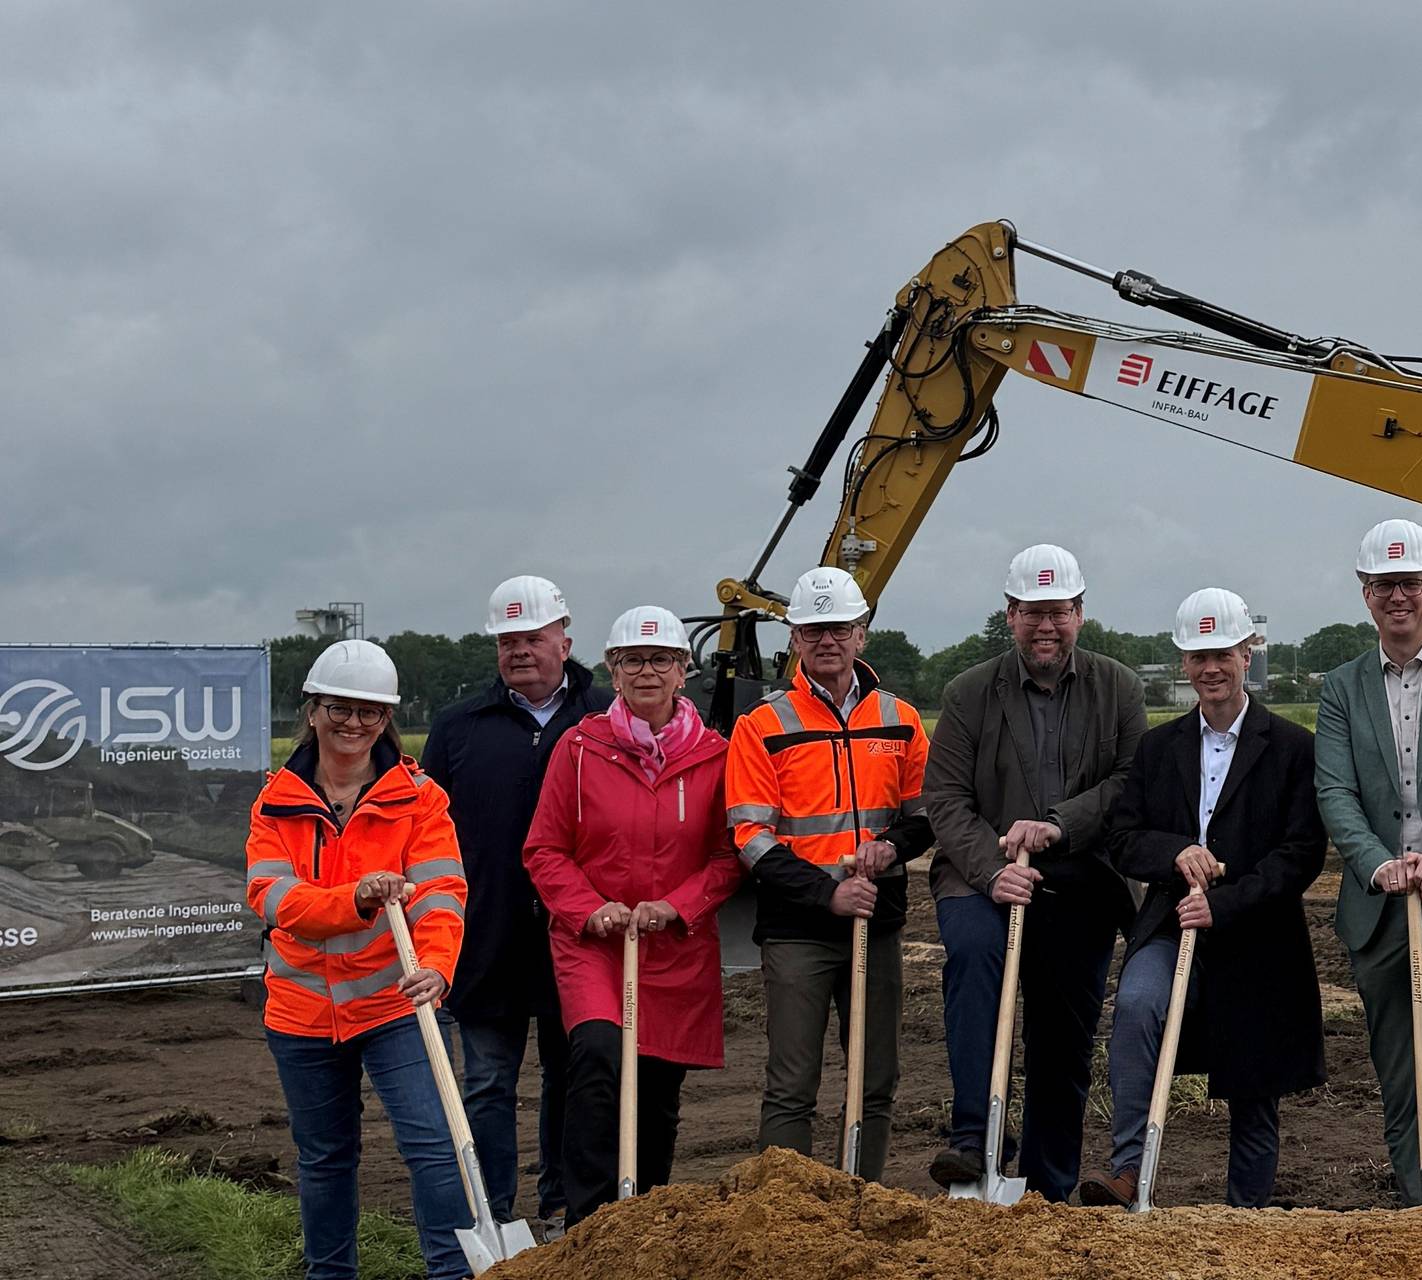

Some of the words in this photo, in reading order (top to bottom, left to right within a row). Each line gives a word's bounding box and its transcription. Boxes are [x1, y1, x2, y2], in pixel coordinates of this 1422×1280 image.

[1156, 370, 1279, 419] EIFFAGE
[1151, 400, 1209, 421] INFRA-BAU
[100, 686, 241, 743] ISW
[100, 747, 177, 765] Ingenieur
[180, 746, 241, 760] Sozietät
[91, 906, 165, 922] Beratende
[168, 902, 243, 919] Ingenieure
[0, 926, 38, 947] se
[91, 919, 244, 941] www.isw-ingenieure.de
